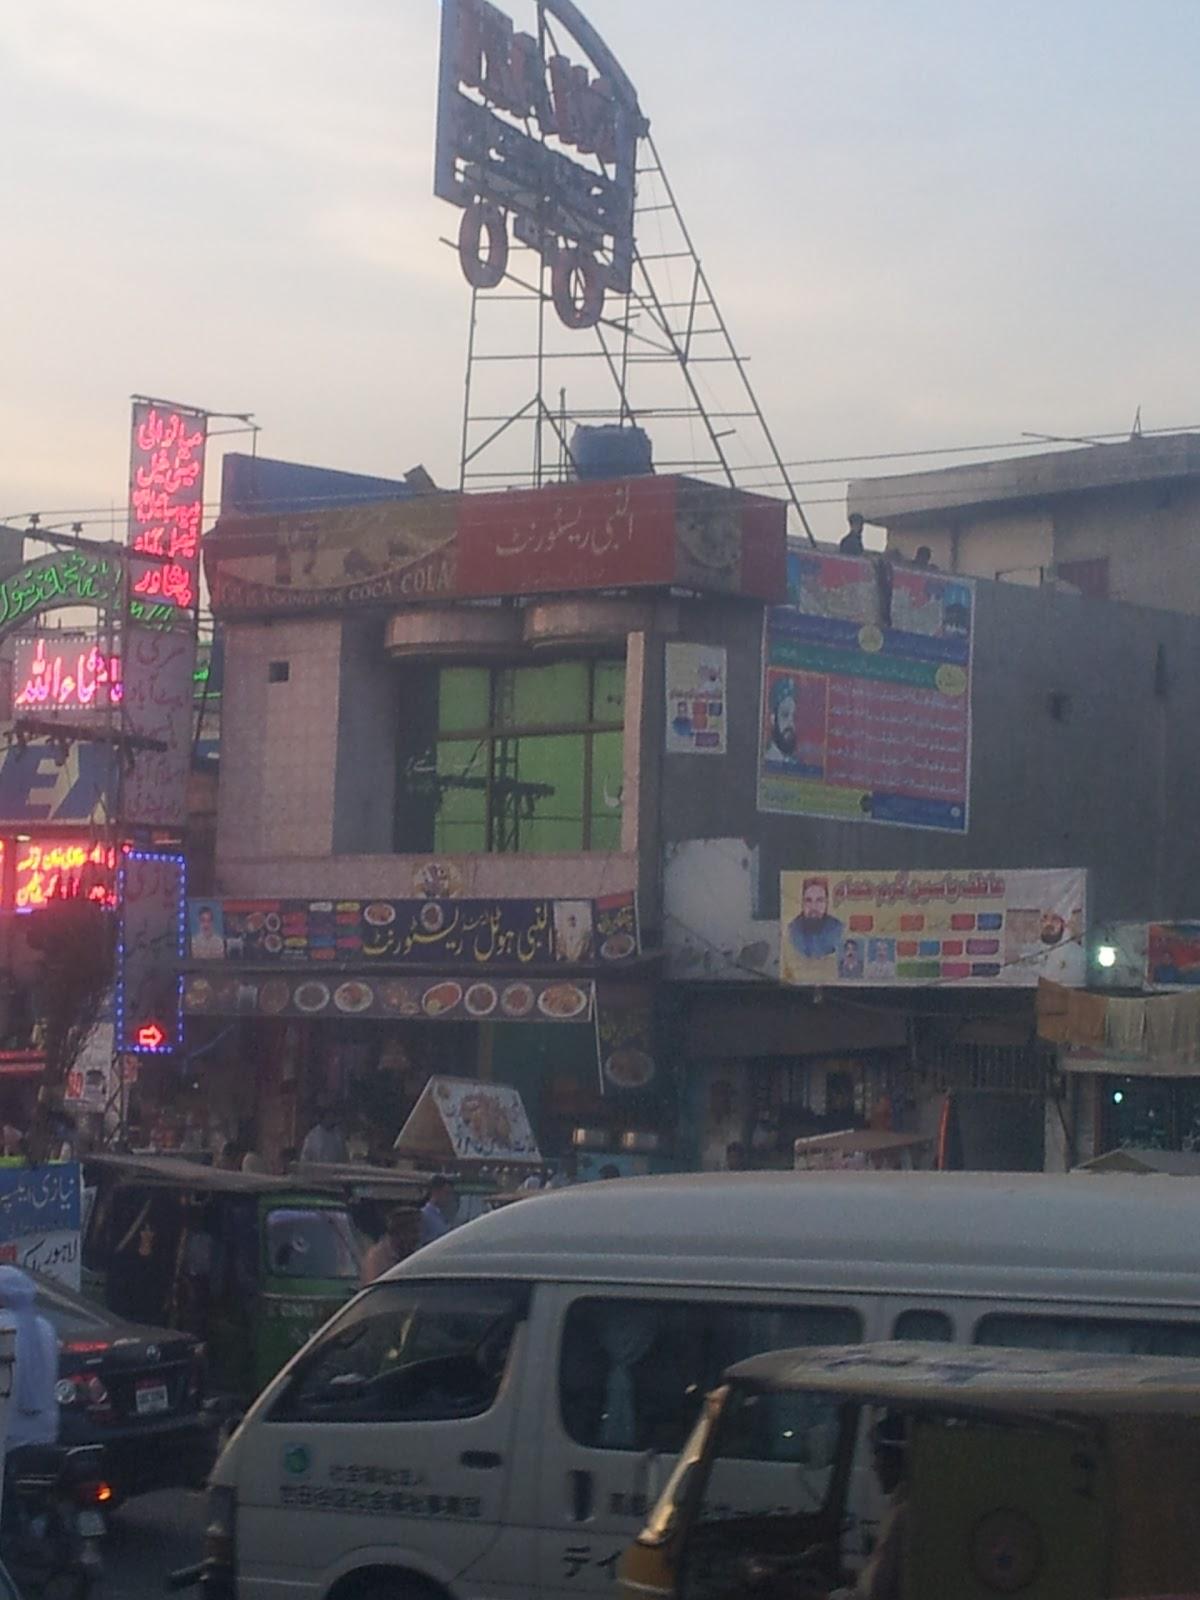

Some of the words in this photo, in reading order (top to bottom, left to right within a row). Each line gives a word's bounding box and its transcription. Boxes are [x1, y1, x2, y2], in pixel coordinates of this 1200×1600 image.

[349, 577, 393, 601] COCA
[362, 903, 463, 955] ریسٹورنٹ
[474, 904, 514, 961] ہوٹل
[33, 1173, 75, 1210] نیازی
[45, 1236, 78, 1265] لاہور
